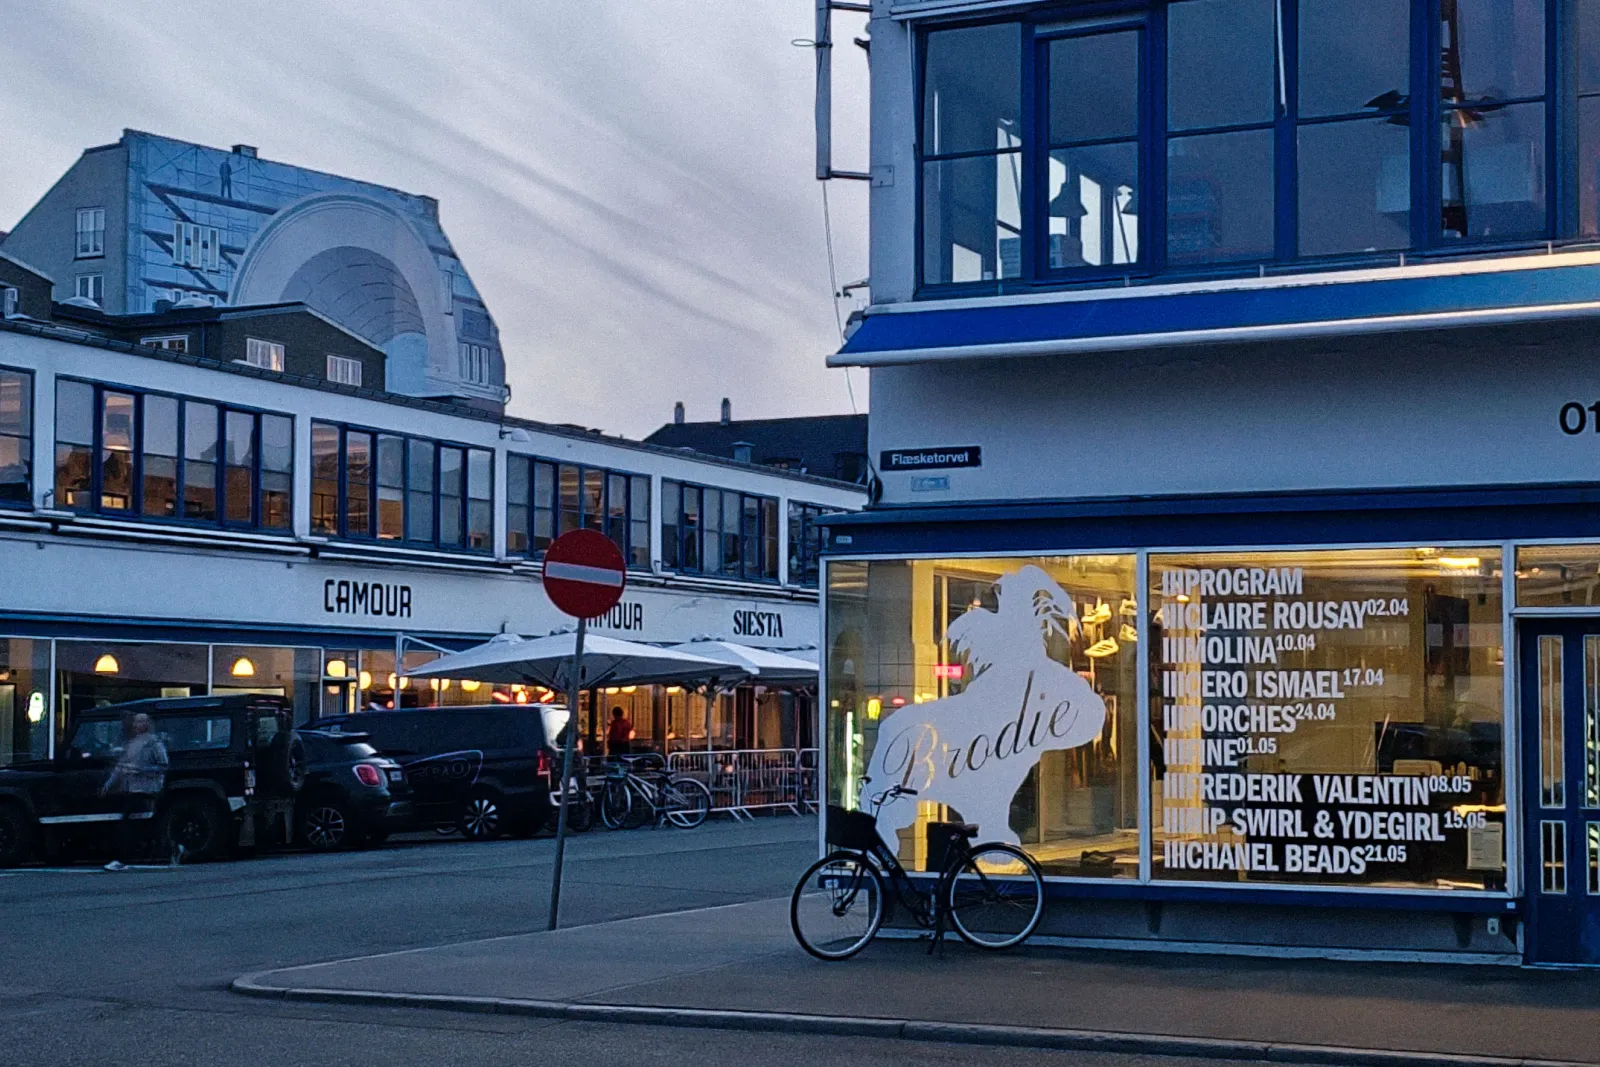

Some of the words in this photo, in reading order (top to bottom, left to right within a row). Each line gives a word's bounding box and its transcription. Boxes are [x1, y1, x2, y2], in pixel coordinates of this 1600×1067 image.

[891, 452, 969, 465] Flæsketorvet
[324, 579, 411, 617] CAMOUR
[733, 610, 783, 638] SIESTA
[1273, 601, 1367, 630] ROUSAY
[1367, 599, 1409, 616] 02.04
[1276, 634, 1316, 651] 10.04
[1255, 671, 1345, 699] ISMAEL
[1343, 669, 1384, 686] 17.04
[1295, 703, 1336, 720] 24.04
[882, 669, 1079, 793] Brodie
[1236, 737, 1277, 754] 01.05
[1312, 776, 1429, 806] VALENTIN
[1428, 775, 1472, 793] 08.05
[1231, 807, 1308, 838] SWIRL
[1313, 810, 1334, 839] &
[1338, 810, 1446, 841] YDEGIRL
[1443, 811, 1487, 829] 15.05
[1285, 843, 1366, 875] BEADS
[1364, 845, 1407, 862] 21.05
